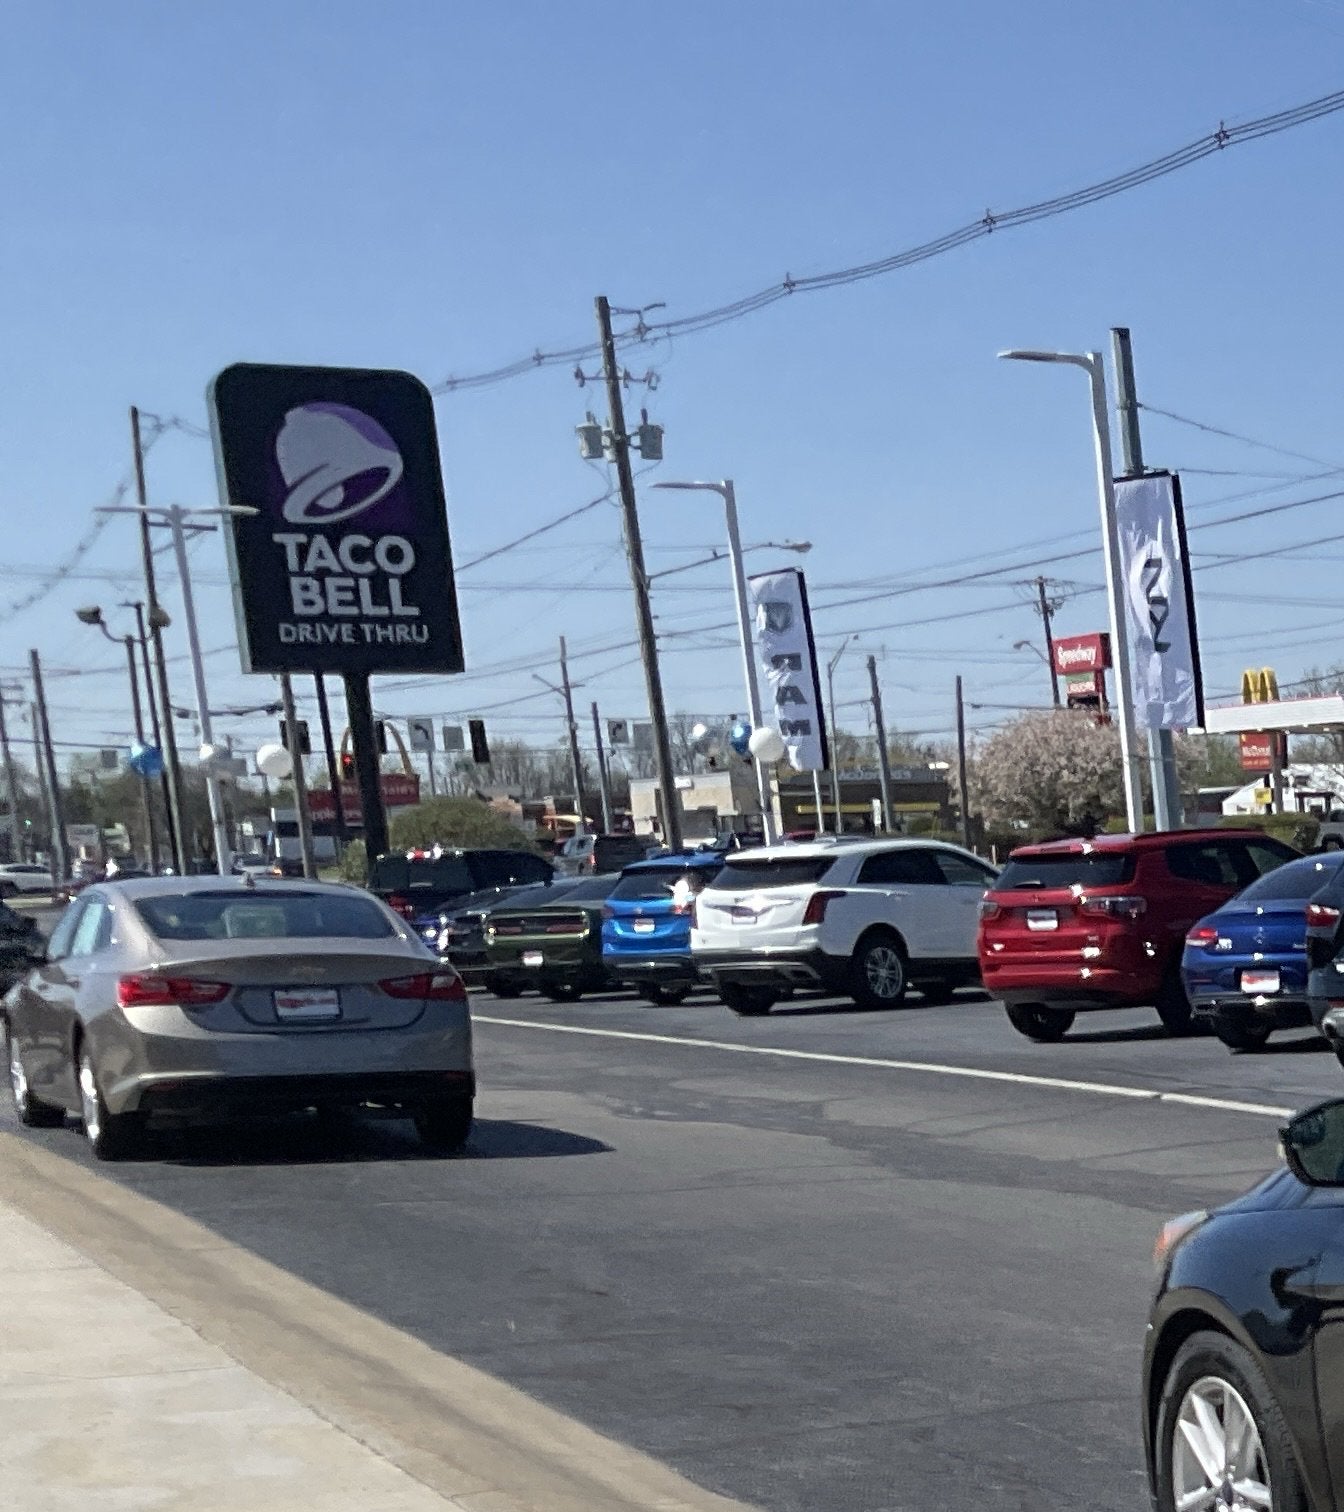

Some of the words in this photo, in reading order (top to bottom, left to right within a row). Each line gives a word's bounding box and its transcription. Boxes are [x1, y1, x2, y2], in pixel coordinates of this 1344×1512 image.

[272, 533, 416, 574] TACO
[290, 576, 420, 616] BELL
[278, 623, 355, 643] DRIVE
[360, 624, 429, 643] THRU
